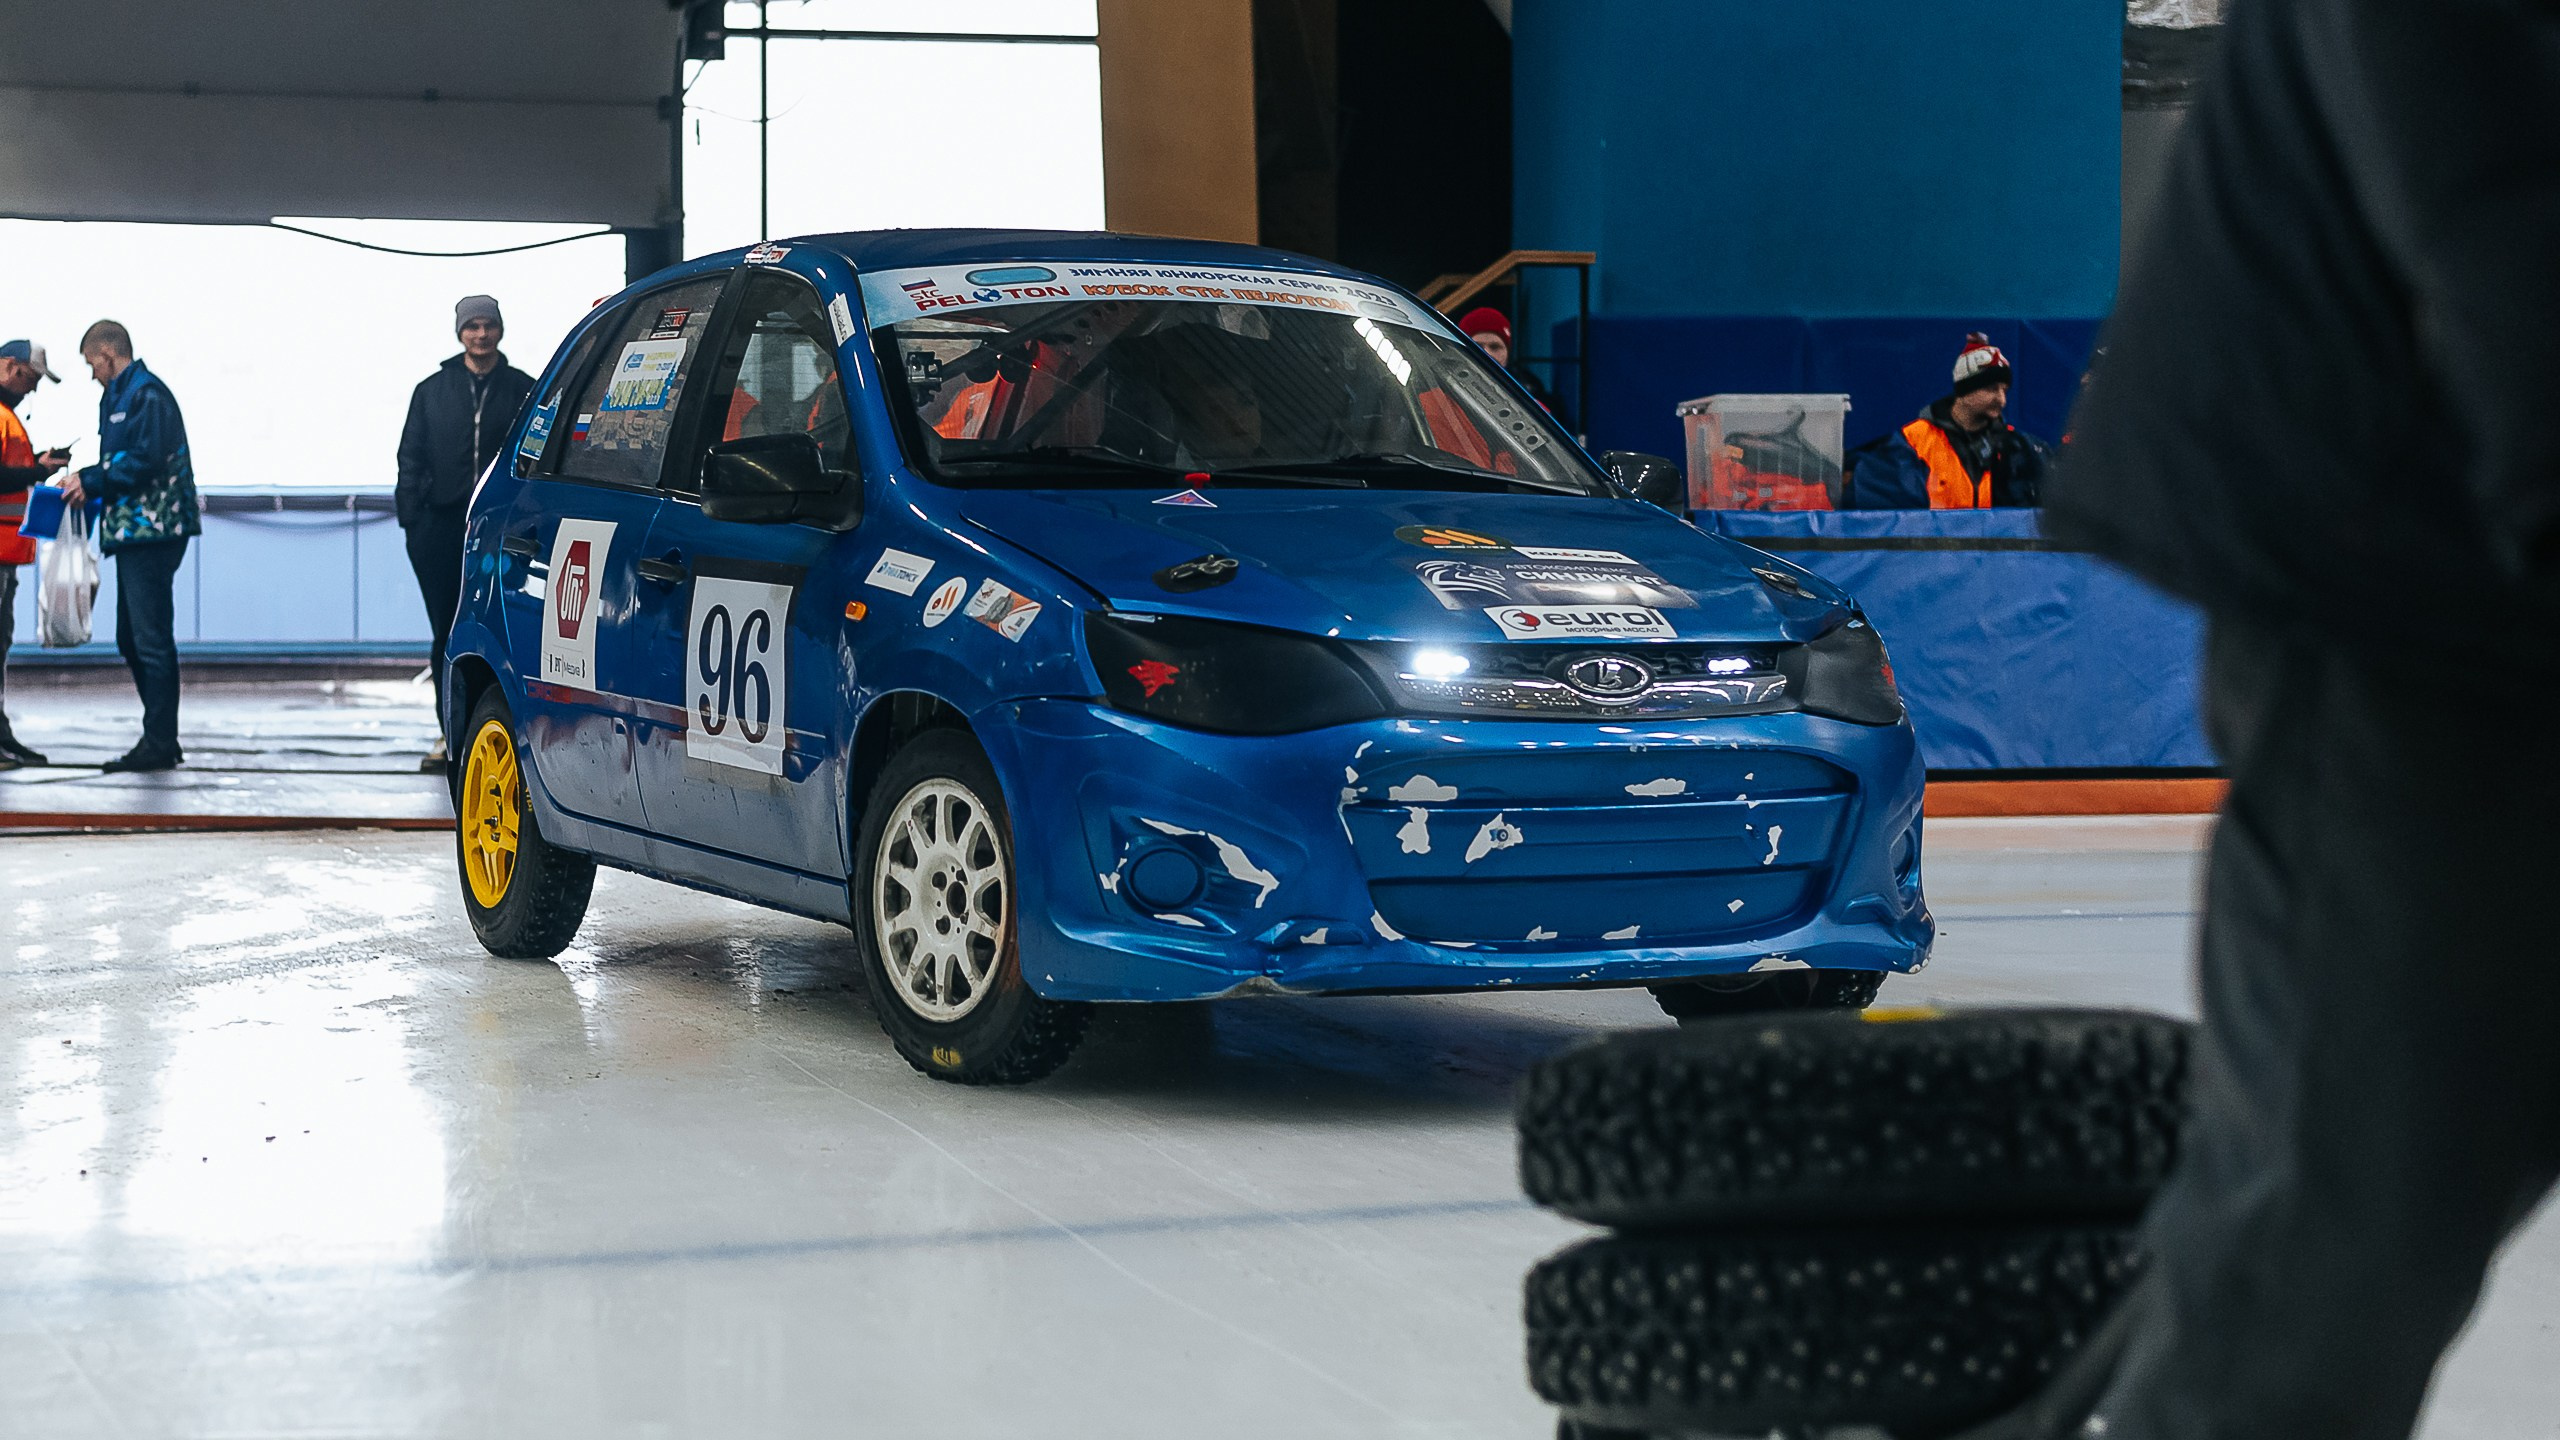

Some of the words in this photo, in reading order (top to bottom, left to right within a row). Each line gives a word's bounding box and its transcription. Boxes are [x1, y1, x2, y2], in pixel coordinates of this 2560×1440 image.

[1068, 268, 1152, 277] ЗИМНЯЯ
[1155, 269, 1275, 285] ЮНИОРСКАЯ
[1278, 278, 1339, 294] СЕРИЯ
[1339, 285, 1397, 307] 2023
[1081, 283, 1174, 296] КУБОК
[1175, 285, 1230, 299] СТК
[1505, 564, 1632, 574] АВТОКОМПЛЕКС
[1515, 571, 1662, 586] СИНДИКАТ
[1542, 608, 1665, 626] eurol
[698, 604, 771, 744] 96
